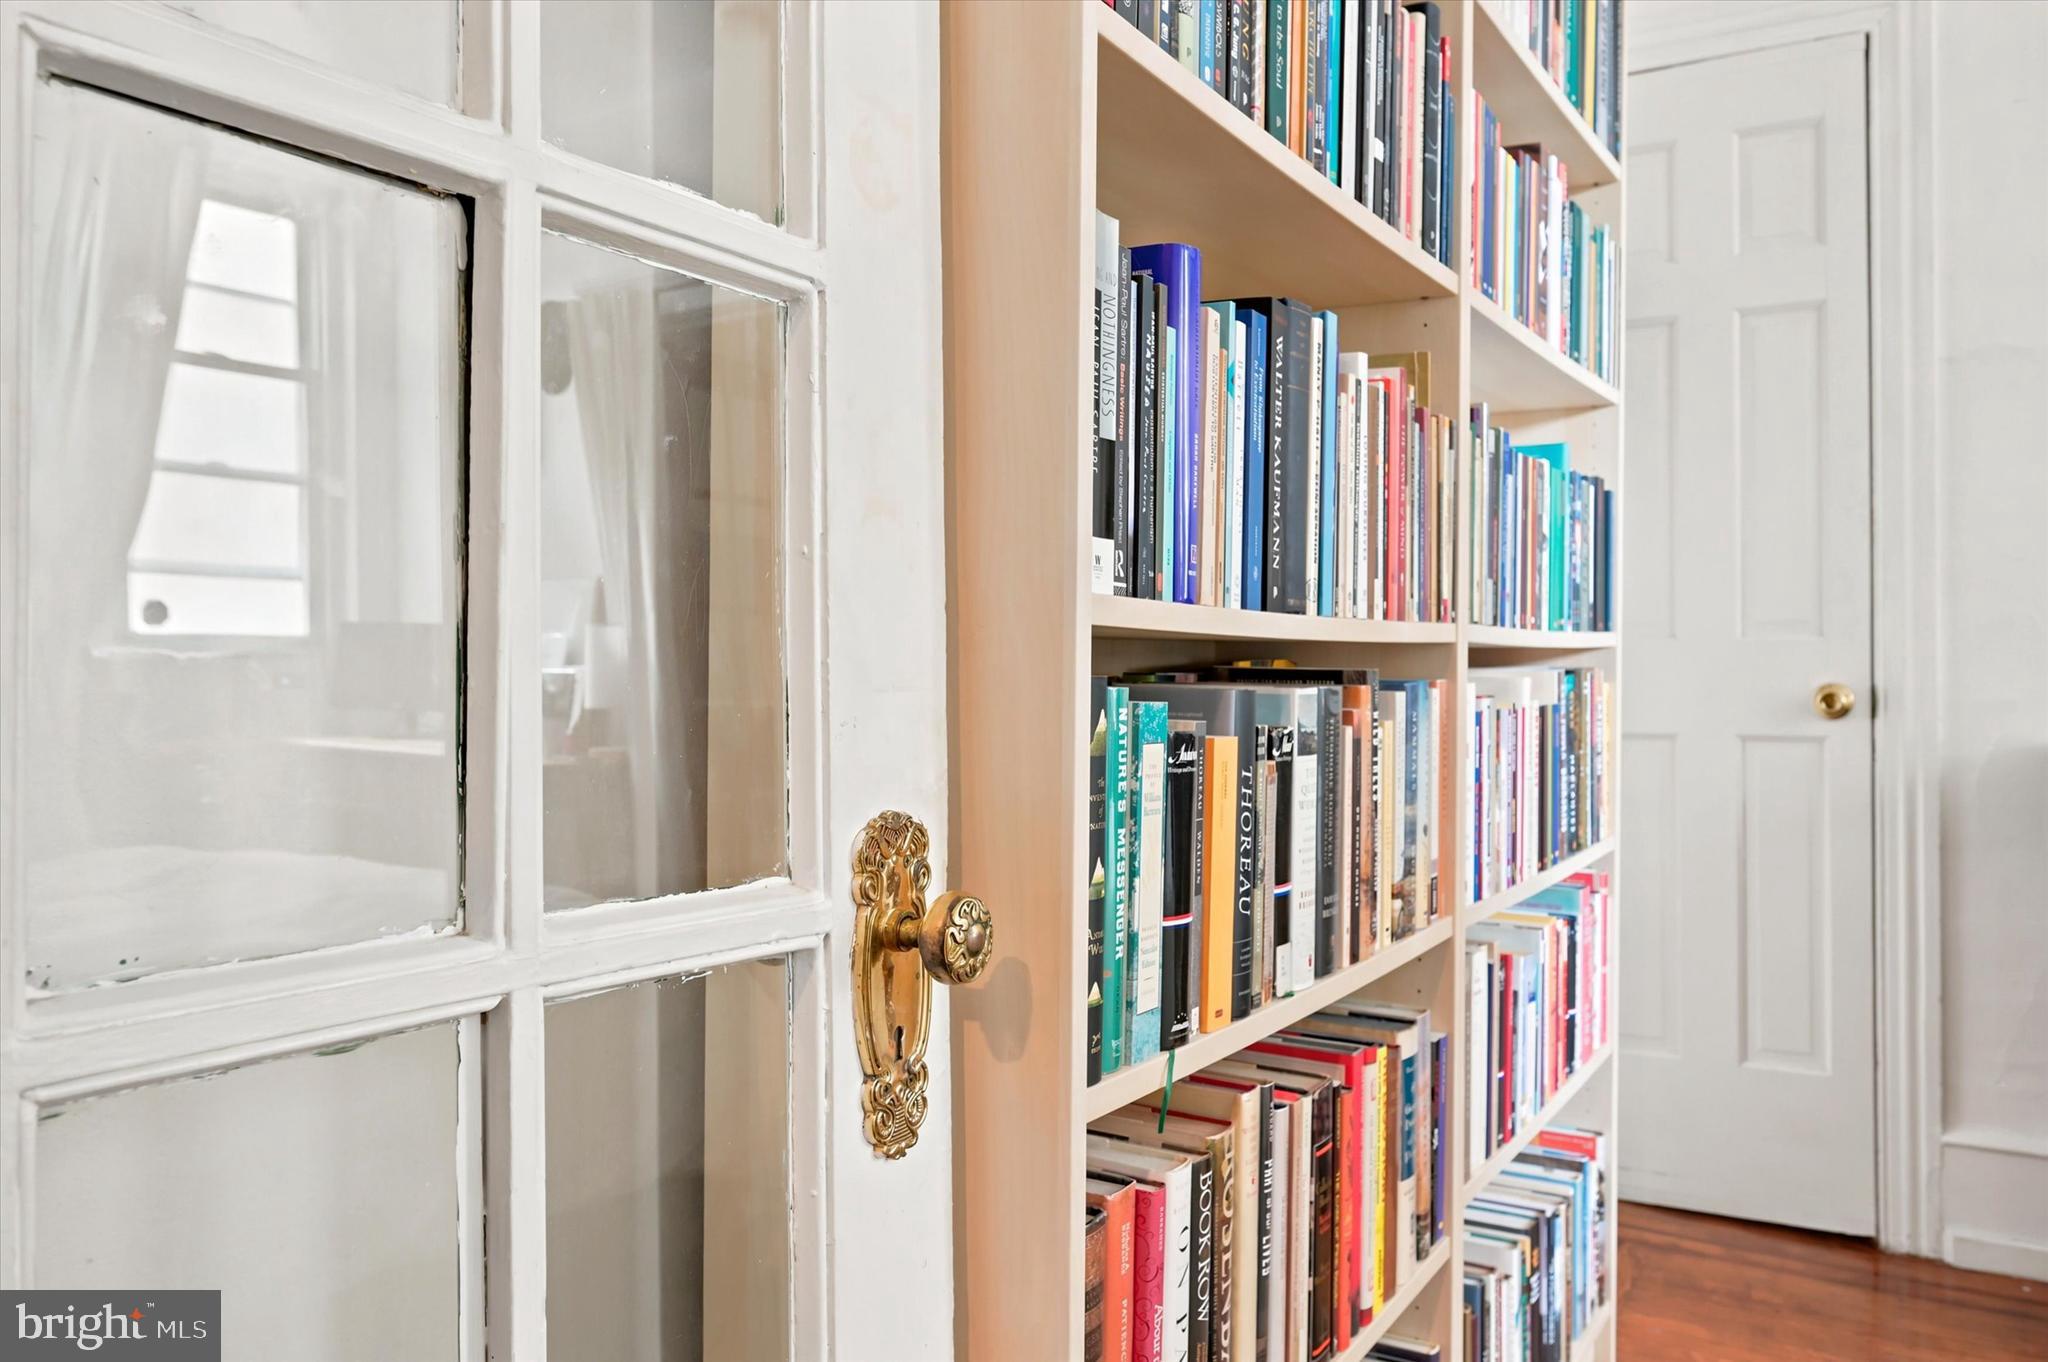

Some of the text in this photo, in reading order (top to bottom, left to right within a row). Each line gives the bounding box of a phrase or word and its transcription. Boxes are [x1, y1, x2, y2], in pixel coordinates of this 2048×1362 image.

[1231, 31, 1239, 60] Jung
[1276, 4, 1283, 20] to
[1275, 53, 1284, 90] Soul
[1120, 252, 1129, 317] Jean-Paul
[1101, 293, 1117, 418] NOTHINGNESS
[1144, 333, 1152, 408] NAUSEA
[1272, 335, 1284, 570] WALTER KAUFMANN
[1410, 709, 1418, 792] MAMMALS
[1115, 707, 1129, 961] NATURE'S MESSENGER
[1239, 765, 1254, 916] THOREAU
[1197, 1170, 1213, 1322] BOOK ROW
[1220, 1149, 1234, 1362] ROSENB
[1153, 1304, 1164, 1354] About
